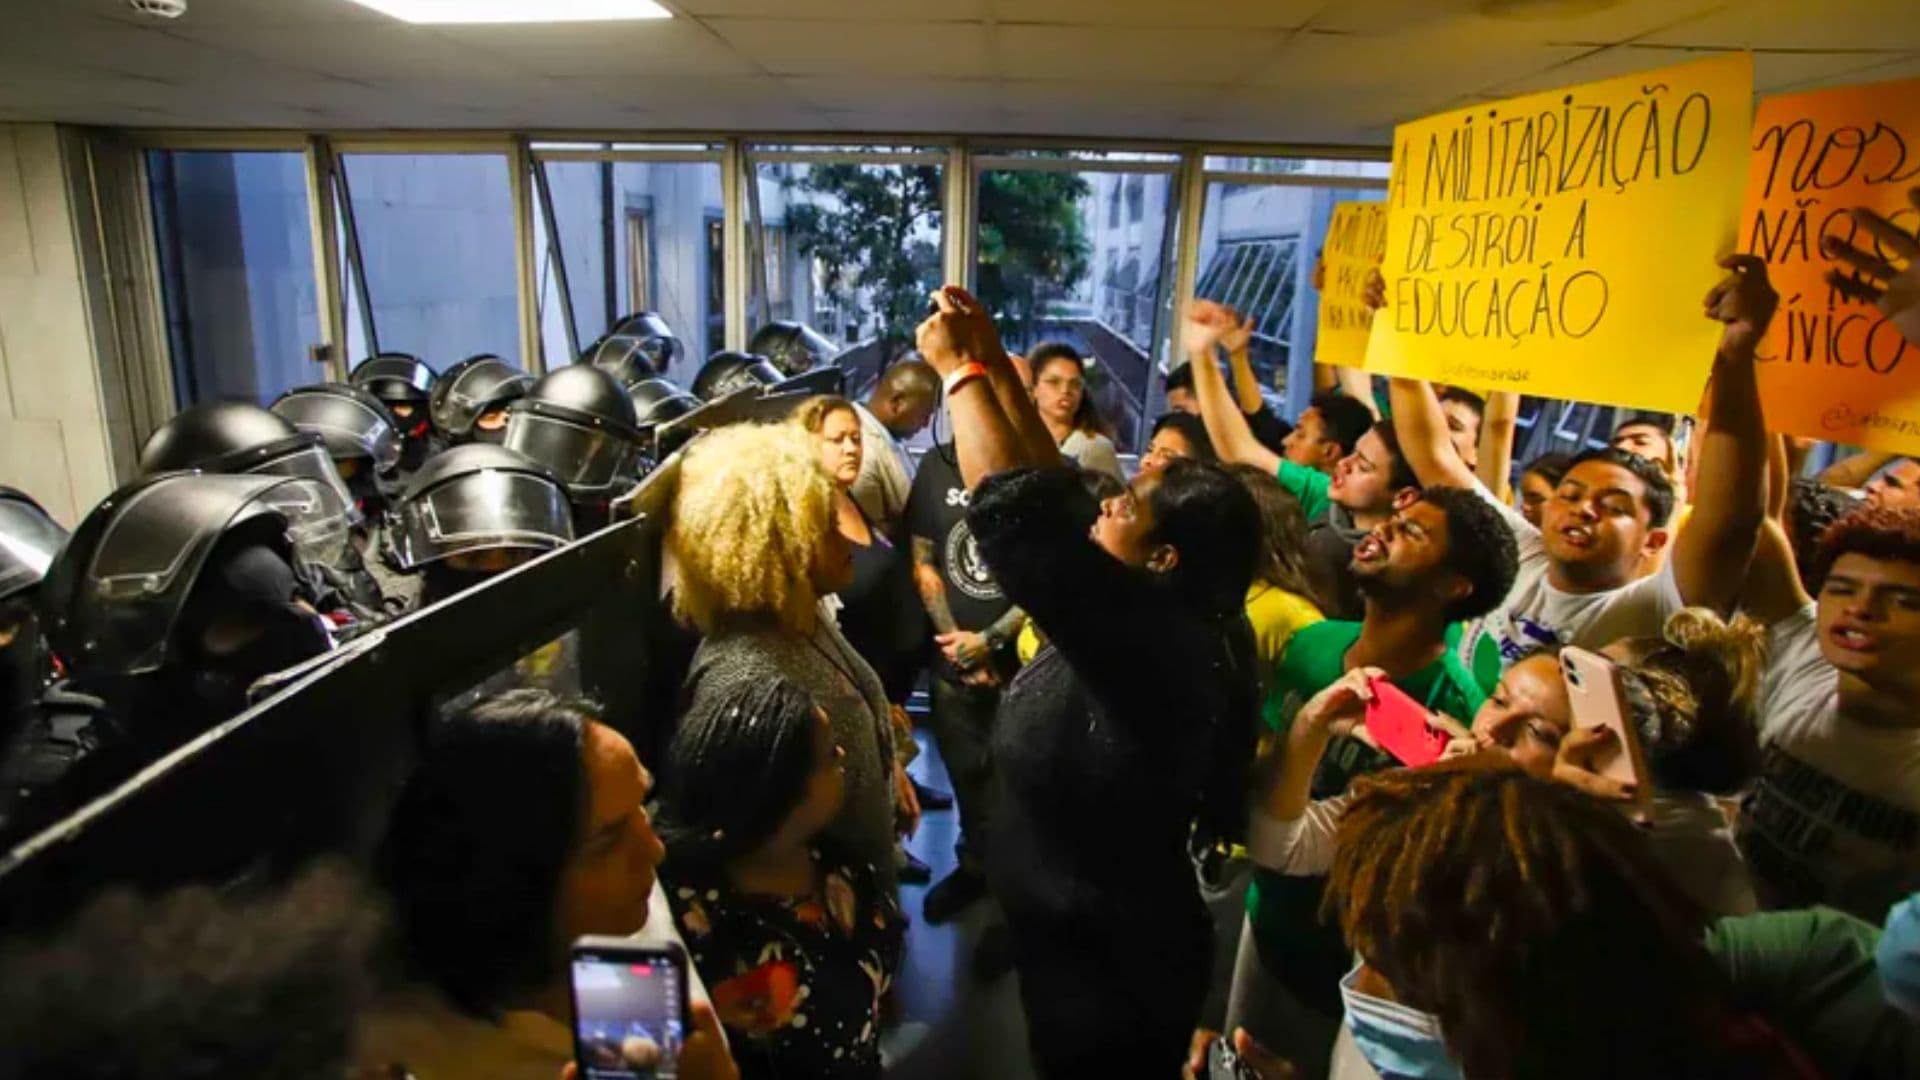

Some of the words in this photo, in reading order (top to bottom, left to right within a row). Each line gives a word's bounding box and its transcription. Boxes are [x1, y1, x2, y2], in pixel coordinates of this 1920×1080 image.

[1392, 136, 1410, 209] A
[1406, 200, 1544, 274] DESTRÓI
[1564, 199, 1586, 259] A
[1754, 292, 1907, 375] ÍVICO
